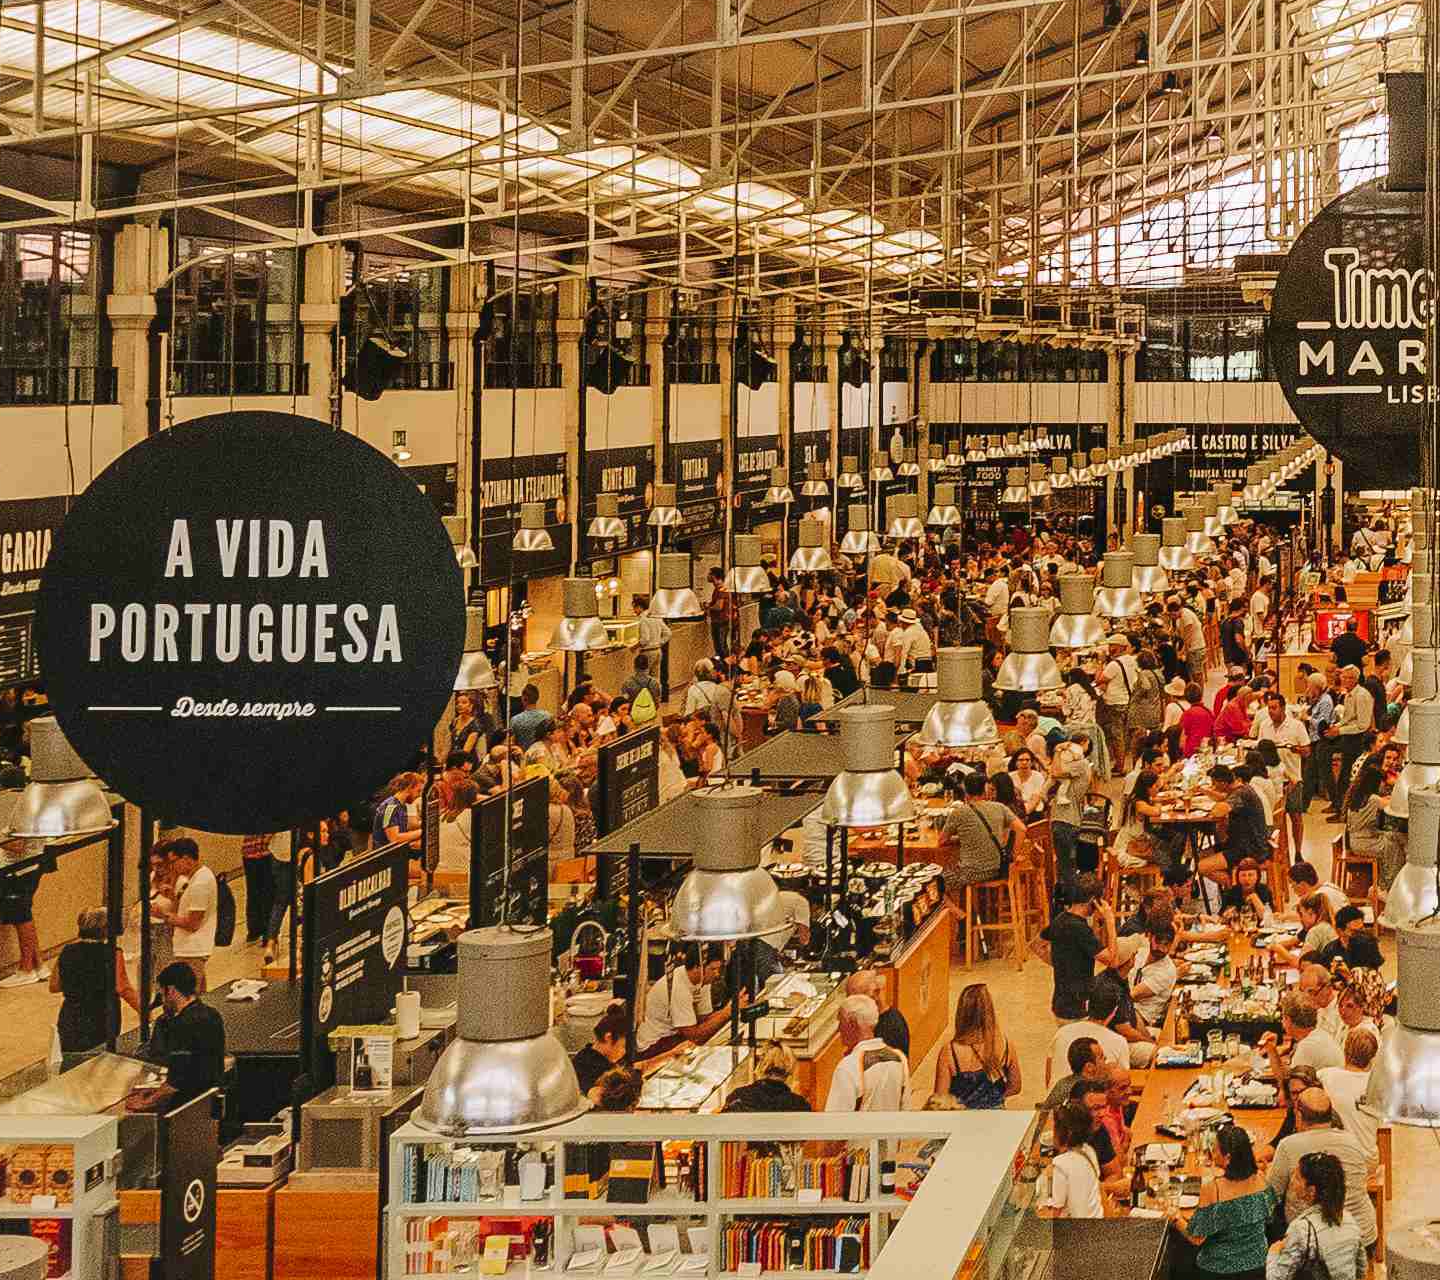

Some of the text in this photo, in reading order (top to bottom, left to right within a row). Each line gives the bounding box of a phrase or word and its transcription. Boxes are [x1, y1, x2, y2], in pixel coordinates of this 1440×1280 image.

[1201, 434, 1247, 451] CASTRO
[1251, 434, 1258, 450] E
[164, 519, 329, 578] A VIDA
[89, 603, 403, 663] PORTUGUESA
[170, 696, 317, 721] Desde sempre
